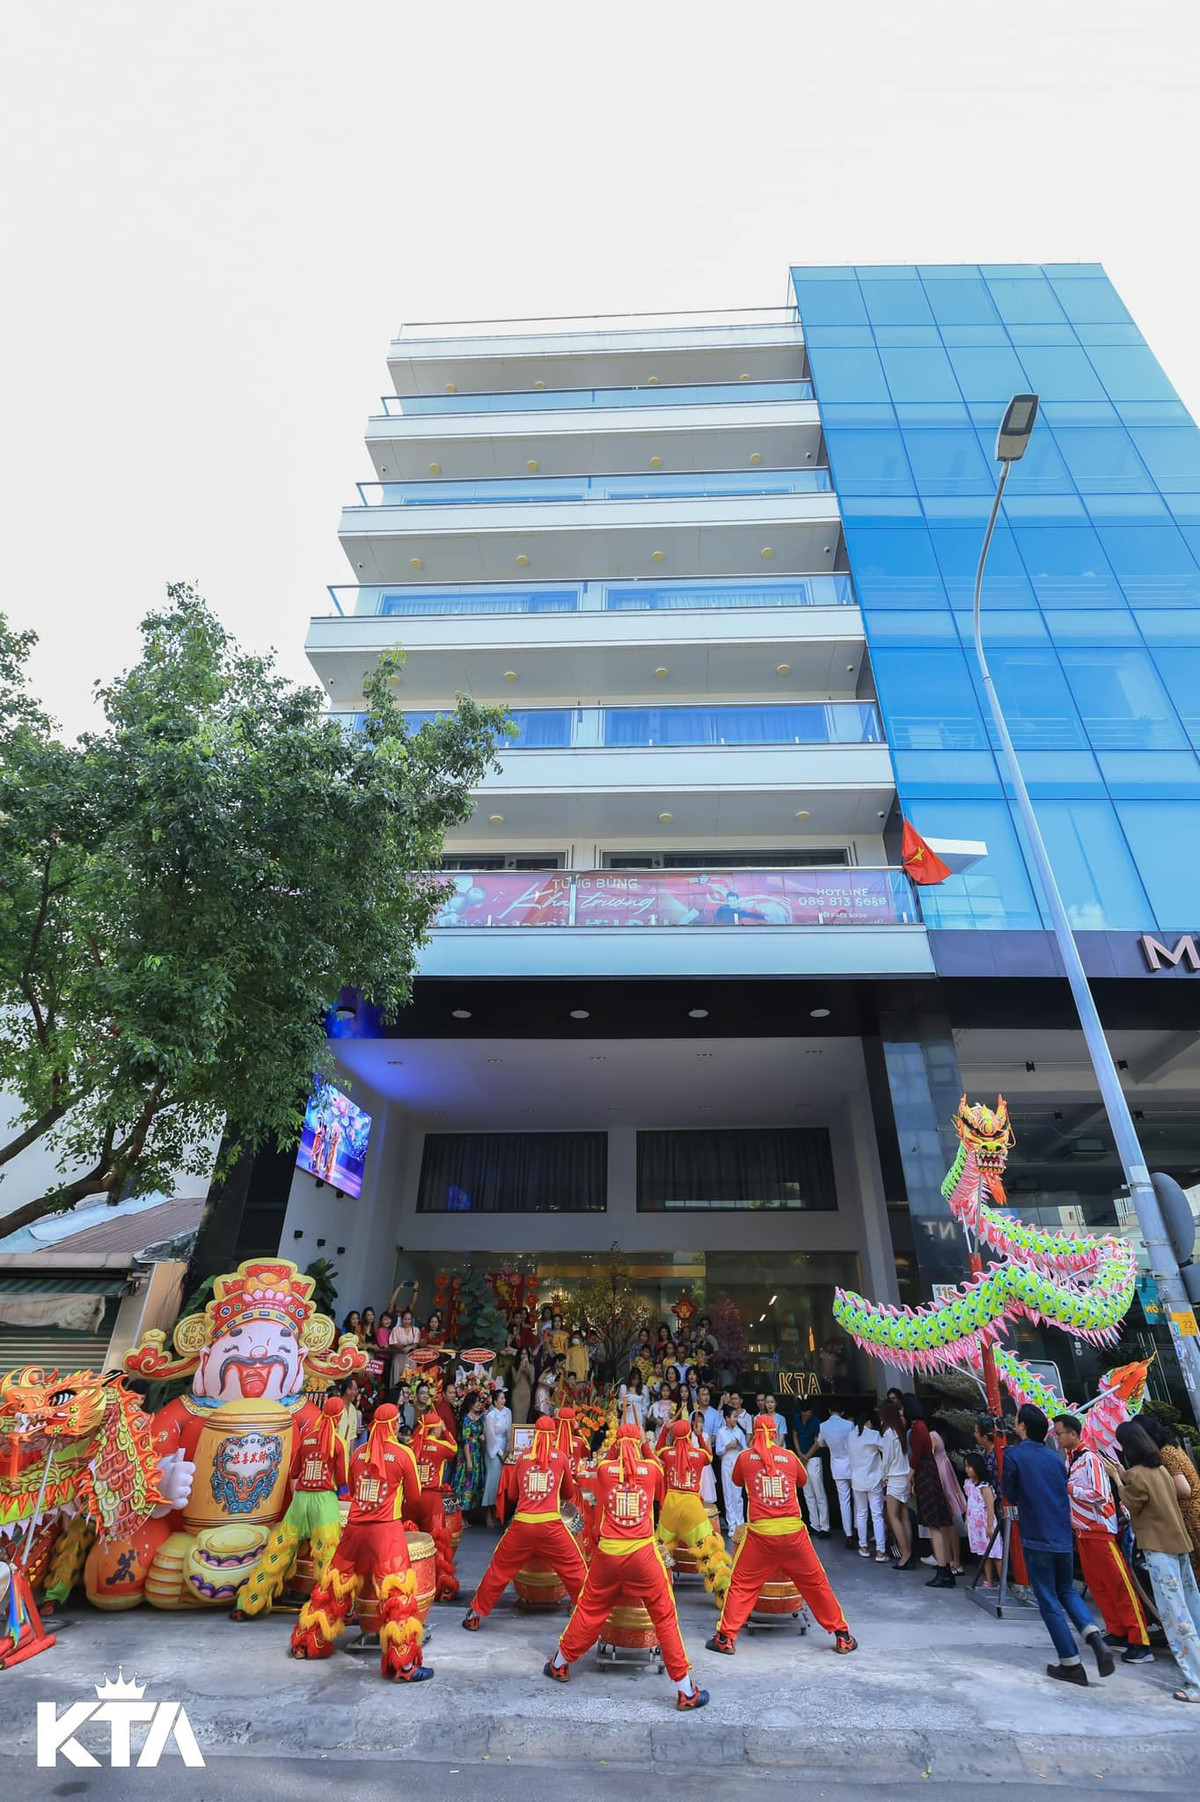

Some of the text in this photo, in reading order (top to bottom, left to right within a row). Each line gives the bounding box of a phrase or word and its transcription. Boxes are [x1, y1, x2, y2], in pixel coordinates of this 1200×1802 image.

[816, 888, 869, 897] HOTLINE
[798, 896, 825, 906] 086
[778, 1372, 822, 1395] KTA
